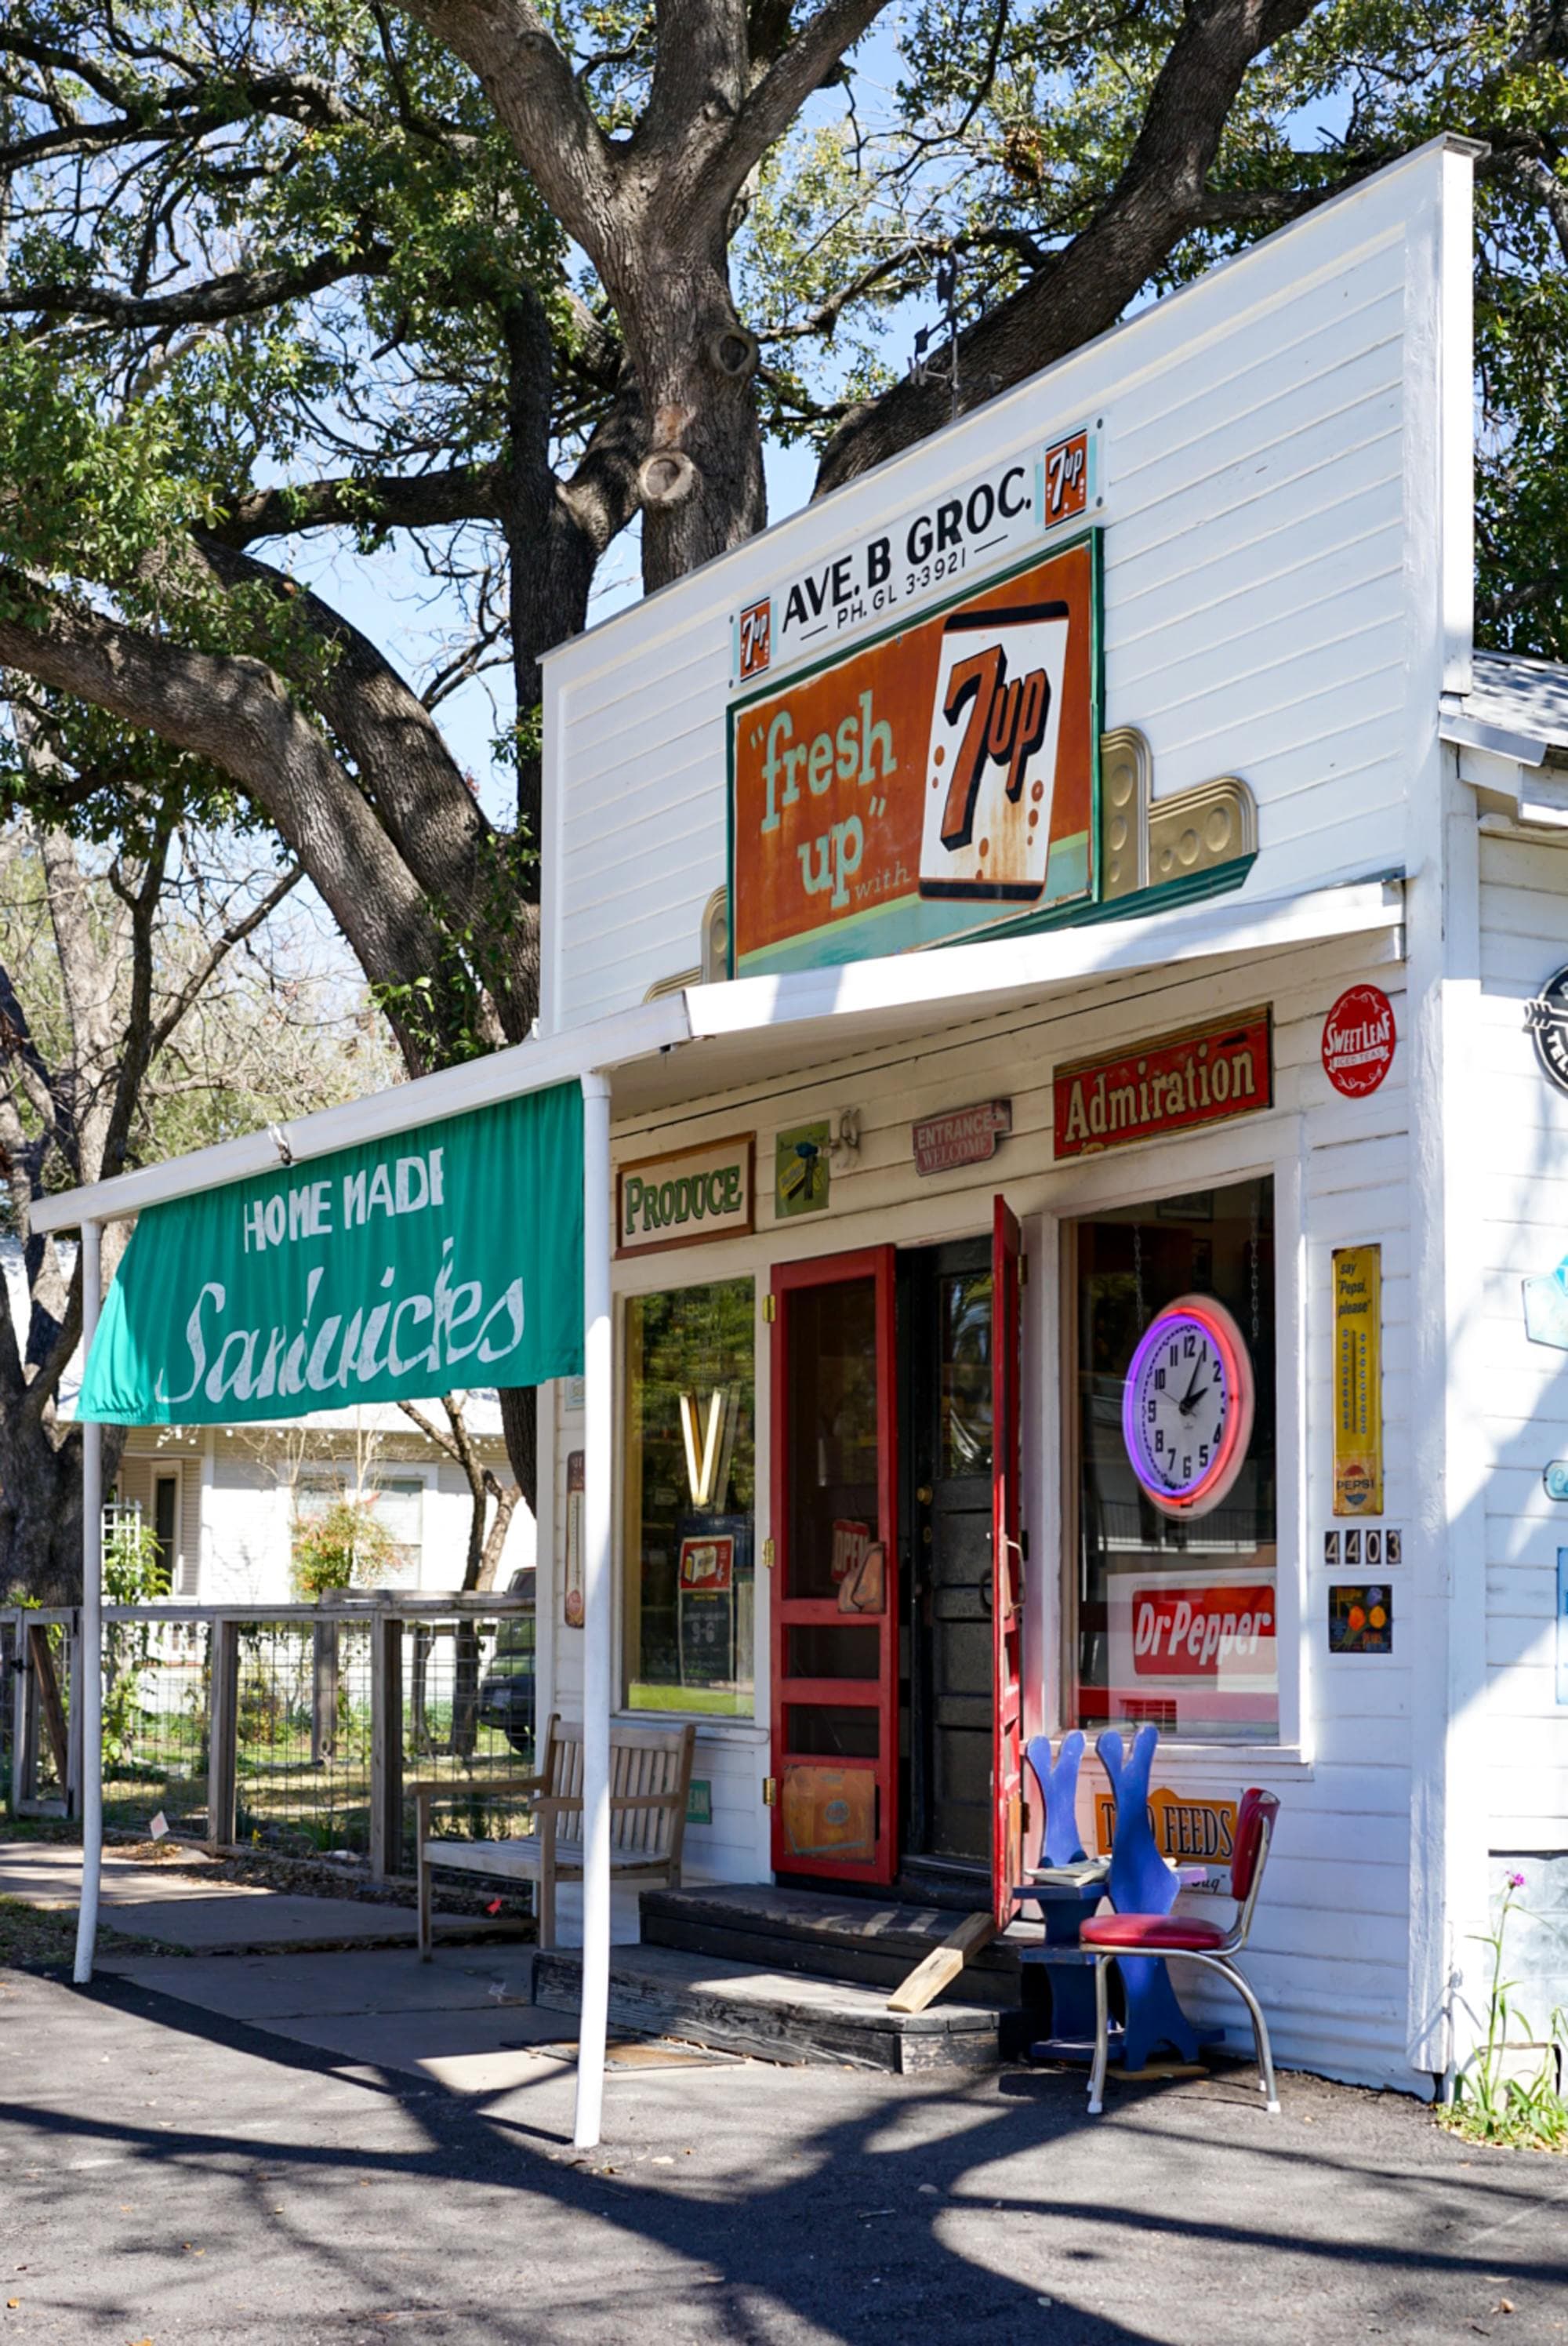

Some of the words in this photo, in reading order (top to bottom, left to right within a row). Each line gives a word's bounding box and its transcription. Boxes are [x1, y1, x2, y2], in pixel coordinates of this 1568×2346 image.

[782, 554, 861, 634] AVE.
[867, 536, 891, 588] B
[906, 467, 1032, 565] GROC.
[837, 597, 868, 629] PH.
[872, 583, 898, 612] GL
[906, 547, 966, 596] 3-3921
[854, 864, 912, 901] with
[1063, 1043, 1256, 1142] Admiration
[917, 1109, 994, 1150] ENTRANCE
[920, 1135, 992, 1168] WELCOME
[624, 1164, 743, 1235] PRODUCE
[244, 1180, 333, 1254] HOME
[1340, 1262, 1357, 1277] say
[1170, 1344, 1179, 1367] 11
[1184, 1335, 1196, 1358] 12
[1155, 1367, 1167, 1390] 10
[1213, 1360, 1222, 1382] 2
[1148, 1400, 1157, 1423] 9
[1156, 1429, 1164, 1453] 8
[1167, 1448, 1176, 1471] 7
[1183, 1455, 1192, 1479] 6
[1200, 1445, 1209, 1468] 5
[1337, 1479, 1374, 1491] PEPSI
[1325, 1531, 1400, 1563] 4403
[1163, 1805, 1233, 1858] FEEDS
